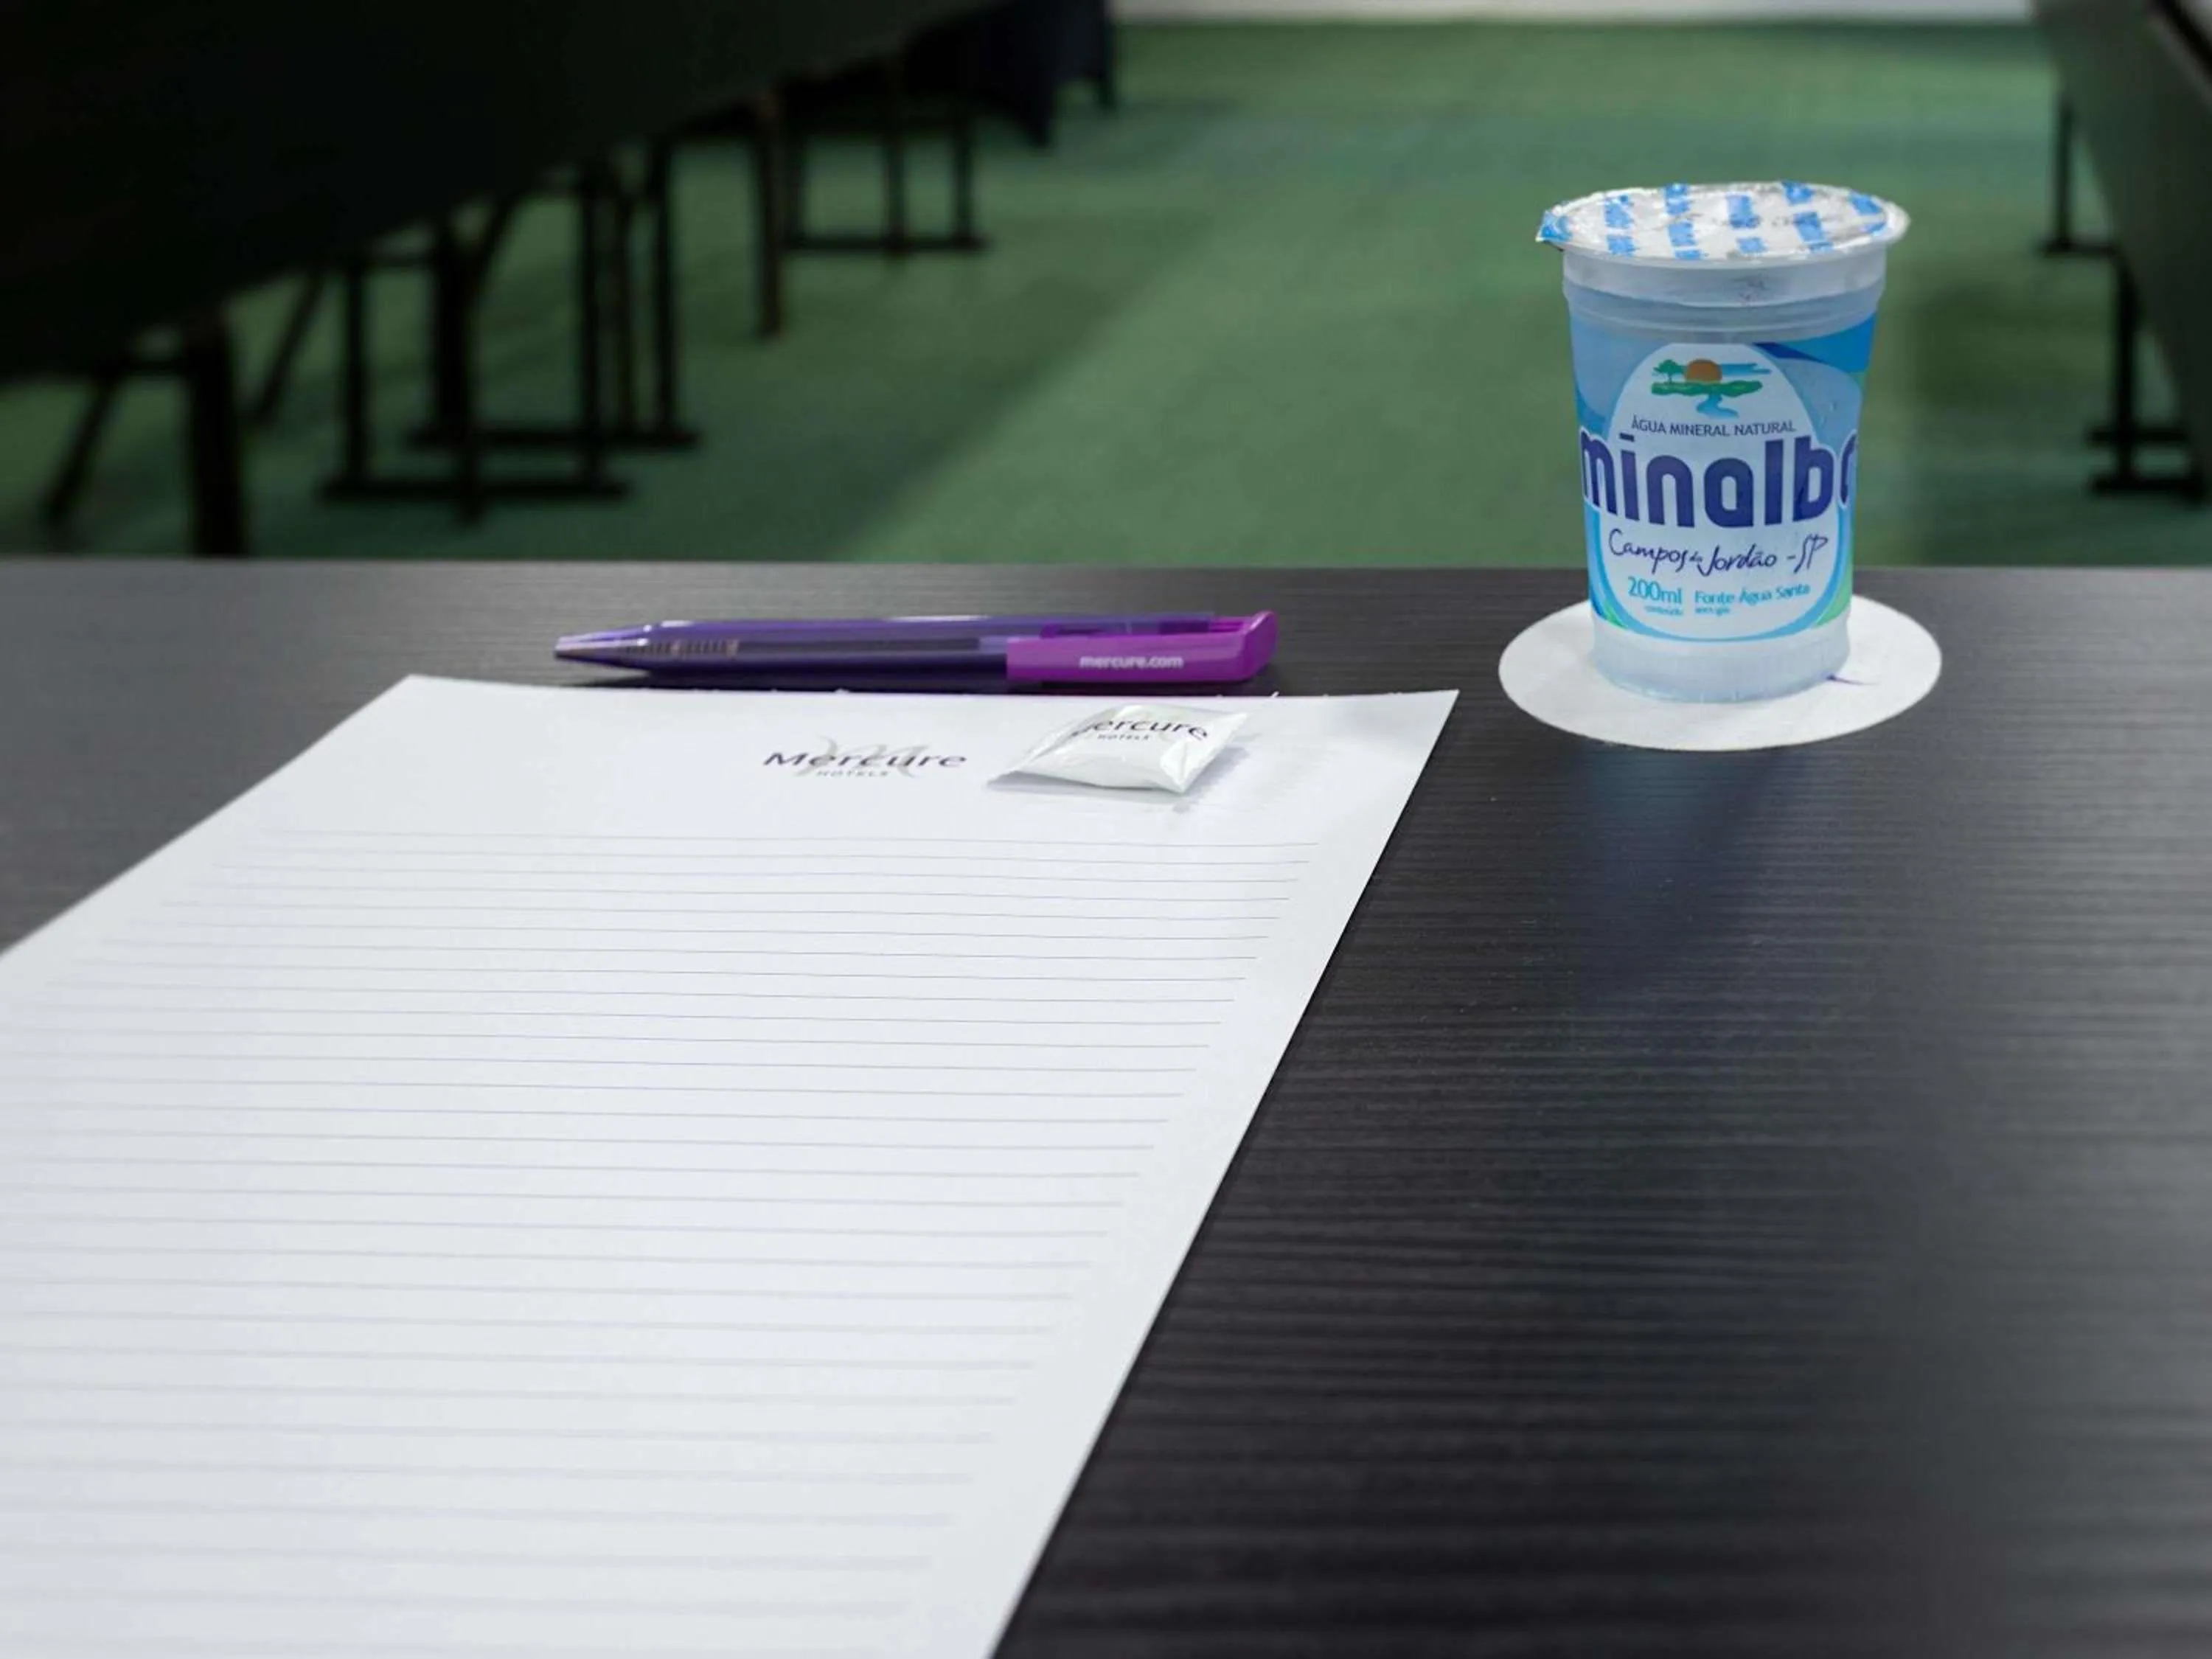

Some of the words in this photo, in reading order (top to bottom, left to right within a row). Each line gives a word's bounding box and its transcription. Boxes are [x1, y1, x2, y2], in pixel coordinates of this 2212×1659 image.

[1631, 414, 1666, 434] ÁGUA
[1669, 422, 1730, 437] MINERAL
[1734, 419, 1797, 437] NATURAL
[1608, 528, 1688, 574] Campos
[1627, 576, 1682, 604] 200ml
[1694, 590, 1735, 604] Fonte
[1775, 583, 1811, 599] Santa
[1079, 655, 1184, 670] mercure.com
[762, 751, 967, 768] Mercure
